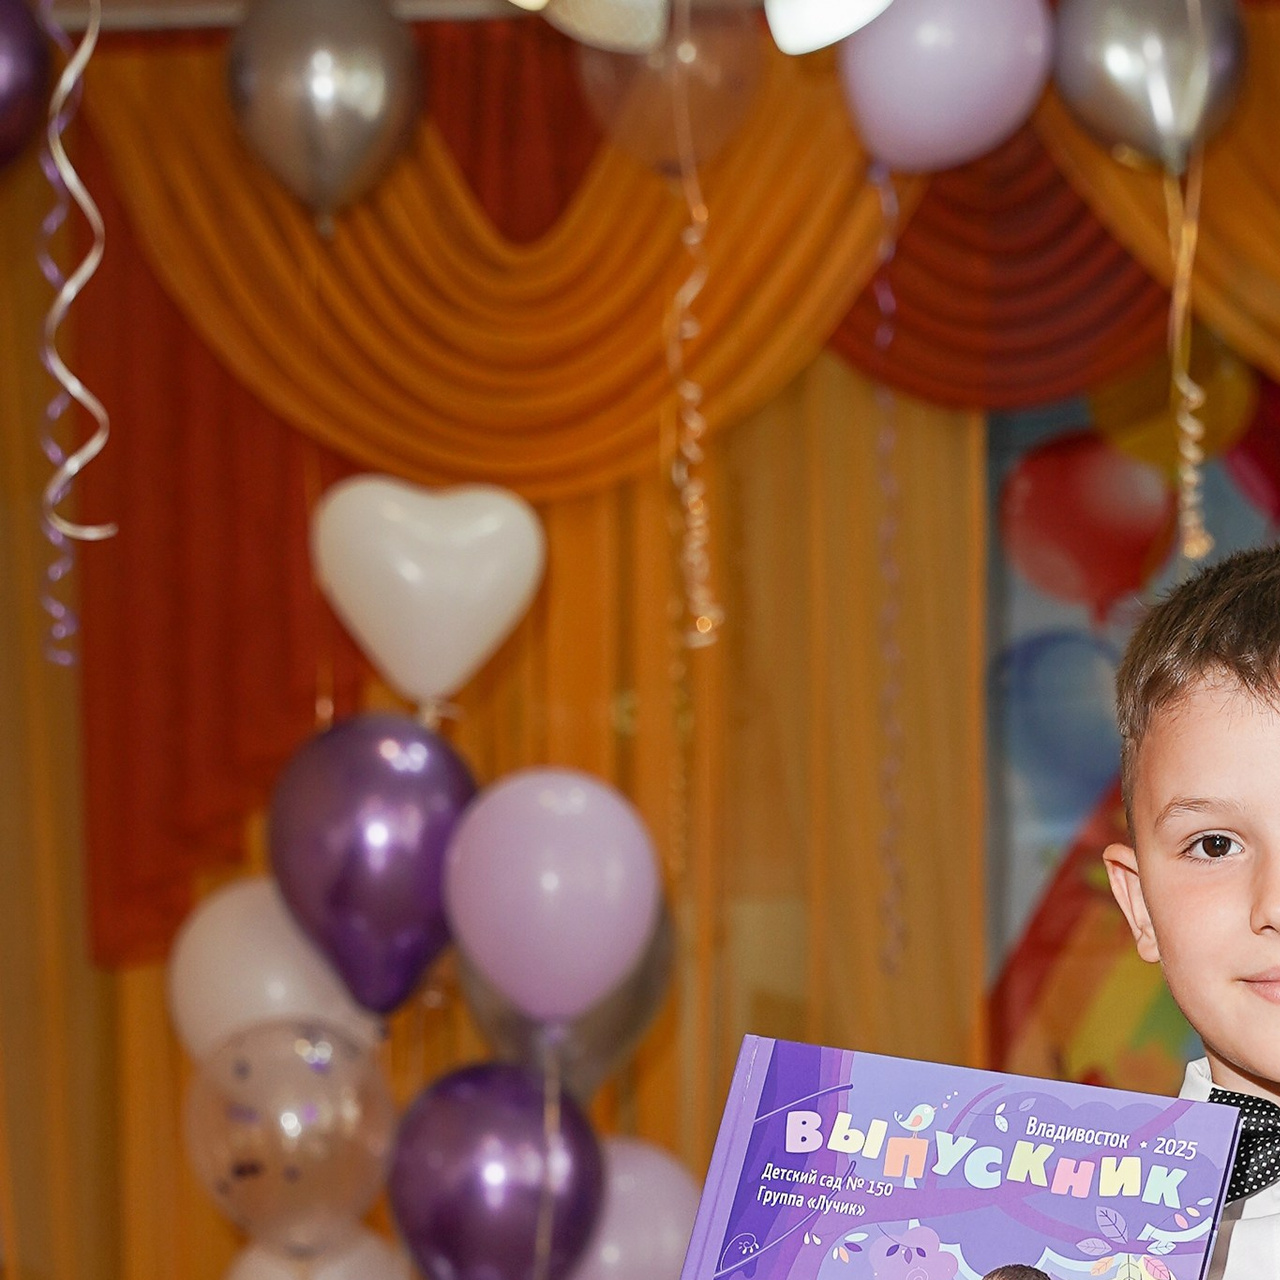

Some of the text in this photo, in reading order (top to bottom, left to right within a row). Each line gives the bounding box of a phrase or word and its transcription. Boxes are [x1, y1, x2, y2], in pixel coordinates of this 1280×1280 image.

[1025, 1115, 1199, 1161] Владивосток 2025
[760, 1162, 894, 1198] Детский сад № 150
[785, 1110, 1189, 1210] ВЫПУСКНИК
[756, 1185, 866, 1217] Группа «Лучик»
